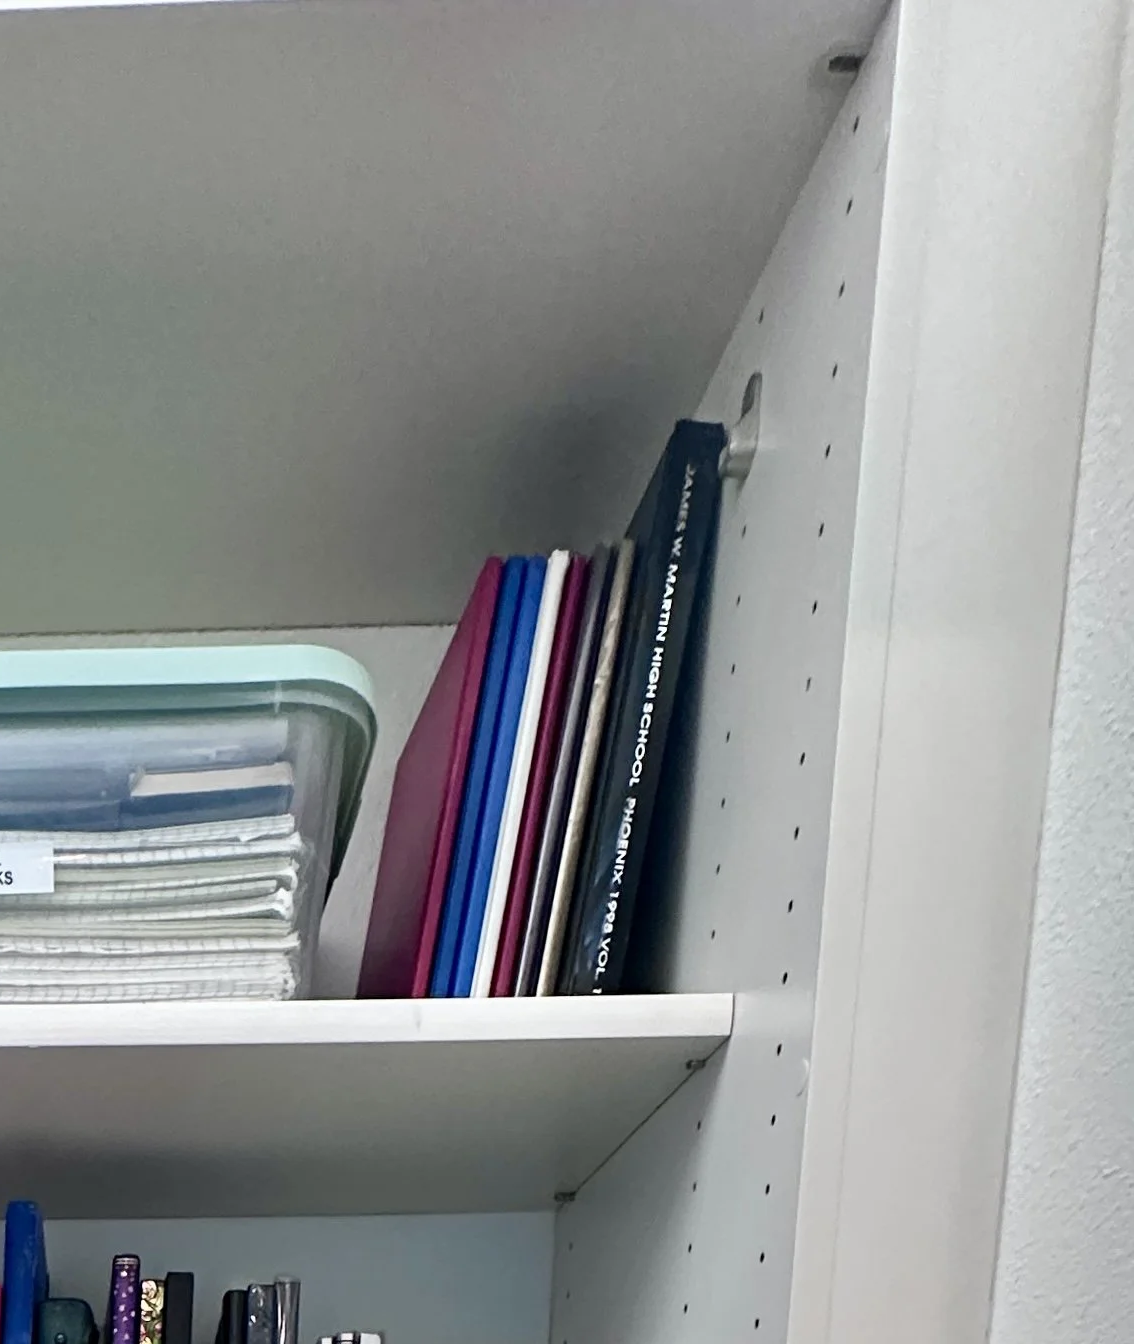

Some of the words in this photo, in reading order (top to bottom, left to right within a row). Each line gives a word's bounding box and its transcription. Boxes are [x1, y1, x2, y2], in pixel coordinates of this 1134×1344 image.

[675, 463, 696, 532] JAMES
[655, 563, 678, 642] MARTIN
[645, 646, 665, 699] HIGH
[628, 702, 654, 787] SCHOOL
[611, 797, 637, 885] PHOENIX
[602, 891, 620, 934] 1998
